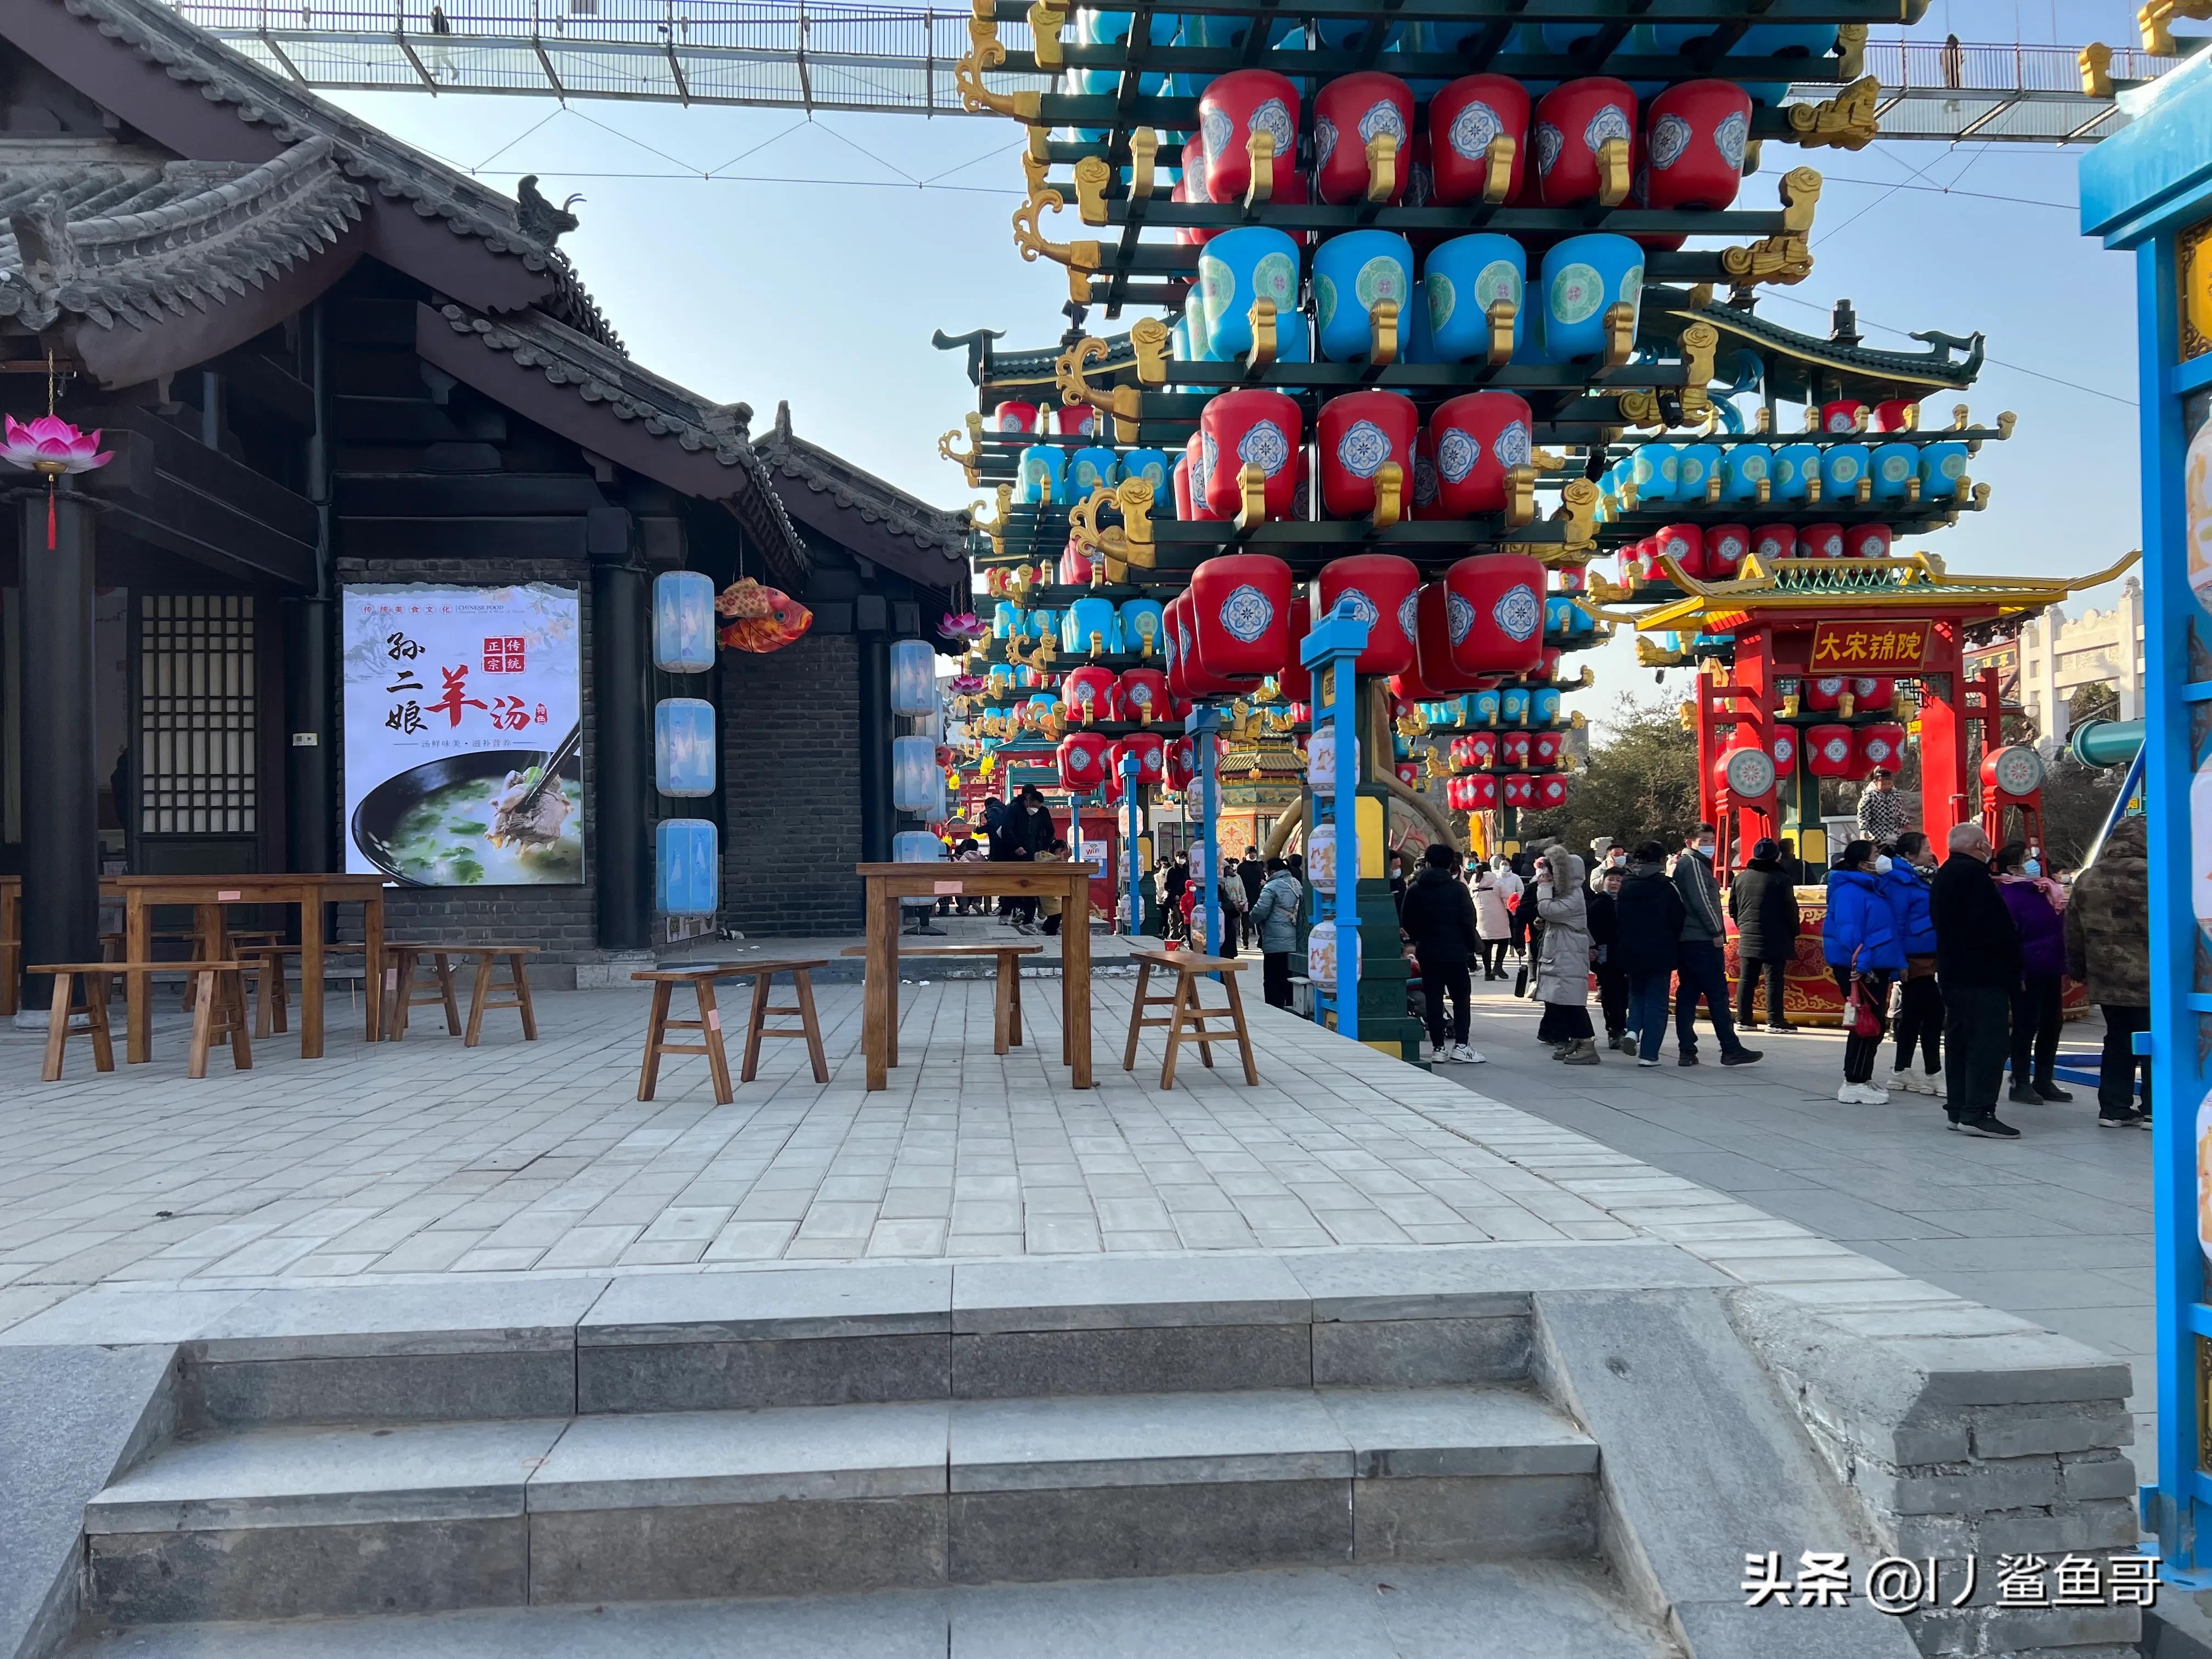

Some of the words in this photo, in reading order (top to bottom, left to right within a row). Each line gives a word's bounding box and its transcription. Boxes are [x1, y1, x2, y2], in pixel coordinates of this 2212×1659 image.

[363, 605, 450, 614] 传统美食文化
[1815, 631, 1921, 661] 大宋锦院
[385, 632, 428, 735] 孙二娘
[424, 664, 531, 731] 羊汤
